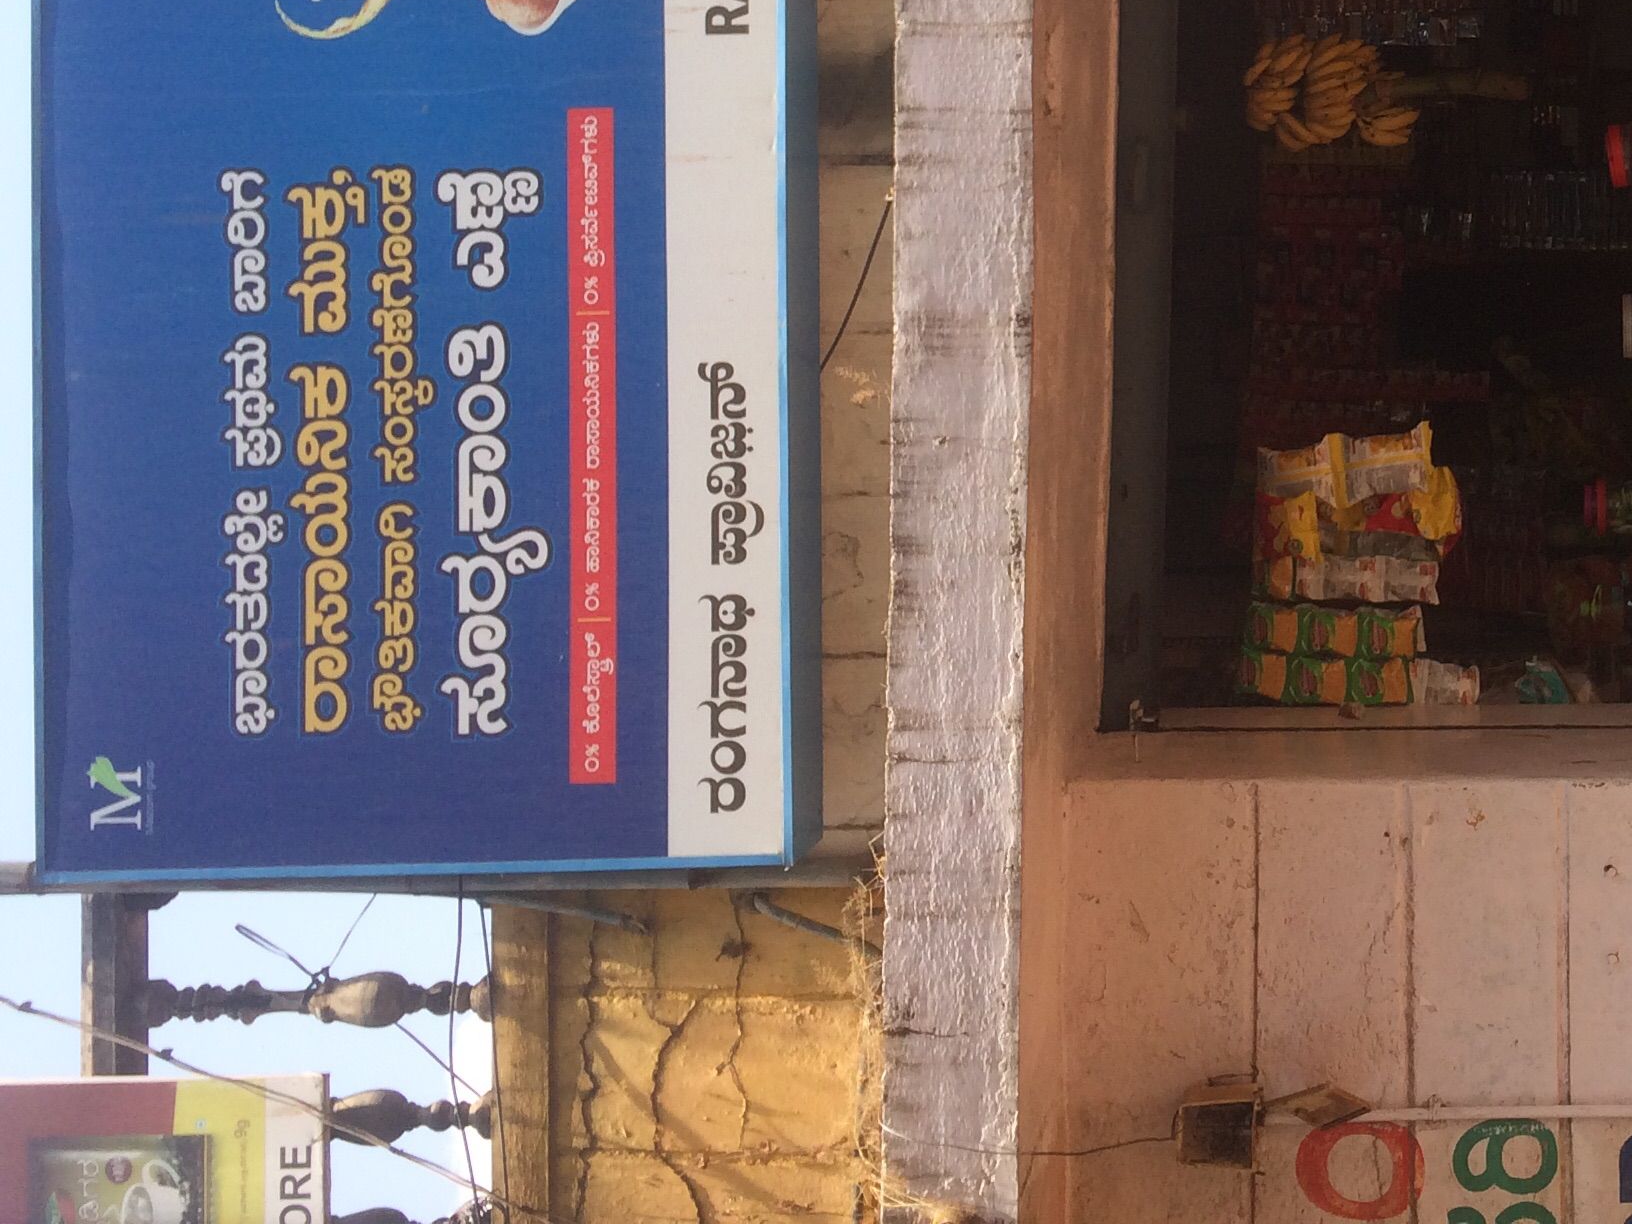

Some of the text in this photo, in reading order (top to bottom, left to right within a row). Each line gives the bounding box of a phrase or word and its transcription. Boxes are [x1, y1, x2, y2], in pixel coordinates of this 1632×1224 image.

[438, 172, 538, 287] ಎಣ್ಣೆ
[221, 172, 283, 733] ಭಾರತದಲ್ಲೇ ಪ್ರಥಮ ಬಾರಿಗೆ
[288, 170, 365, 732] ರಾಸಾಯನಿಕ ಮುಕ್ತ,
[372, 169, 433, 730] ಭೌತಿಕವಾಗಿ ಸಂಸ್ಕರಣೆಗೊಂಡ
[583, 322, 599, 468] ರಾಸಾಯನಿಕಗಳು
[583, 478, 599, 572] ಹಾನಿಕಾರಕ
[699, 594, 755, 813] ರಂಗನಾಥ
